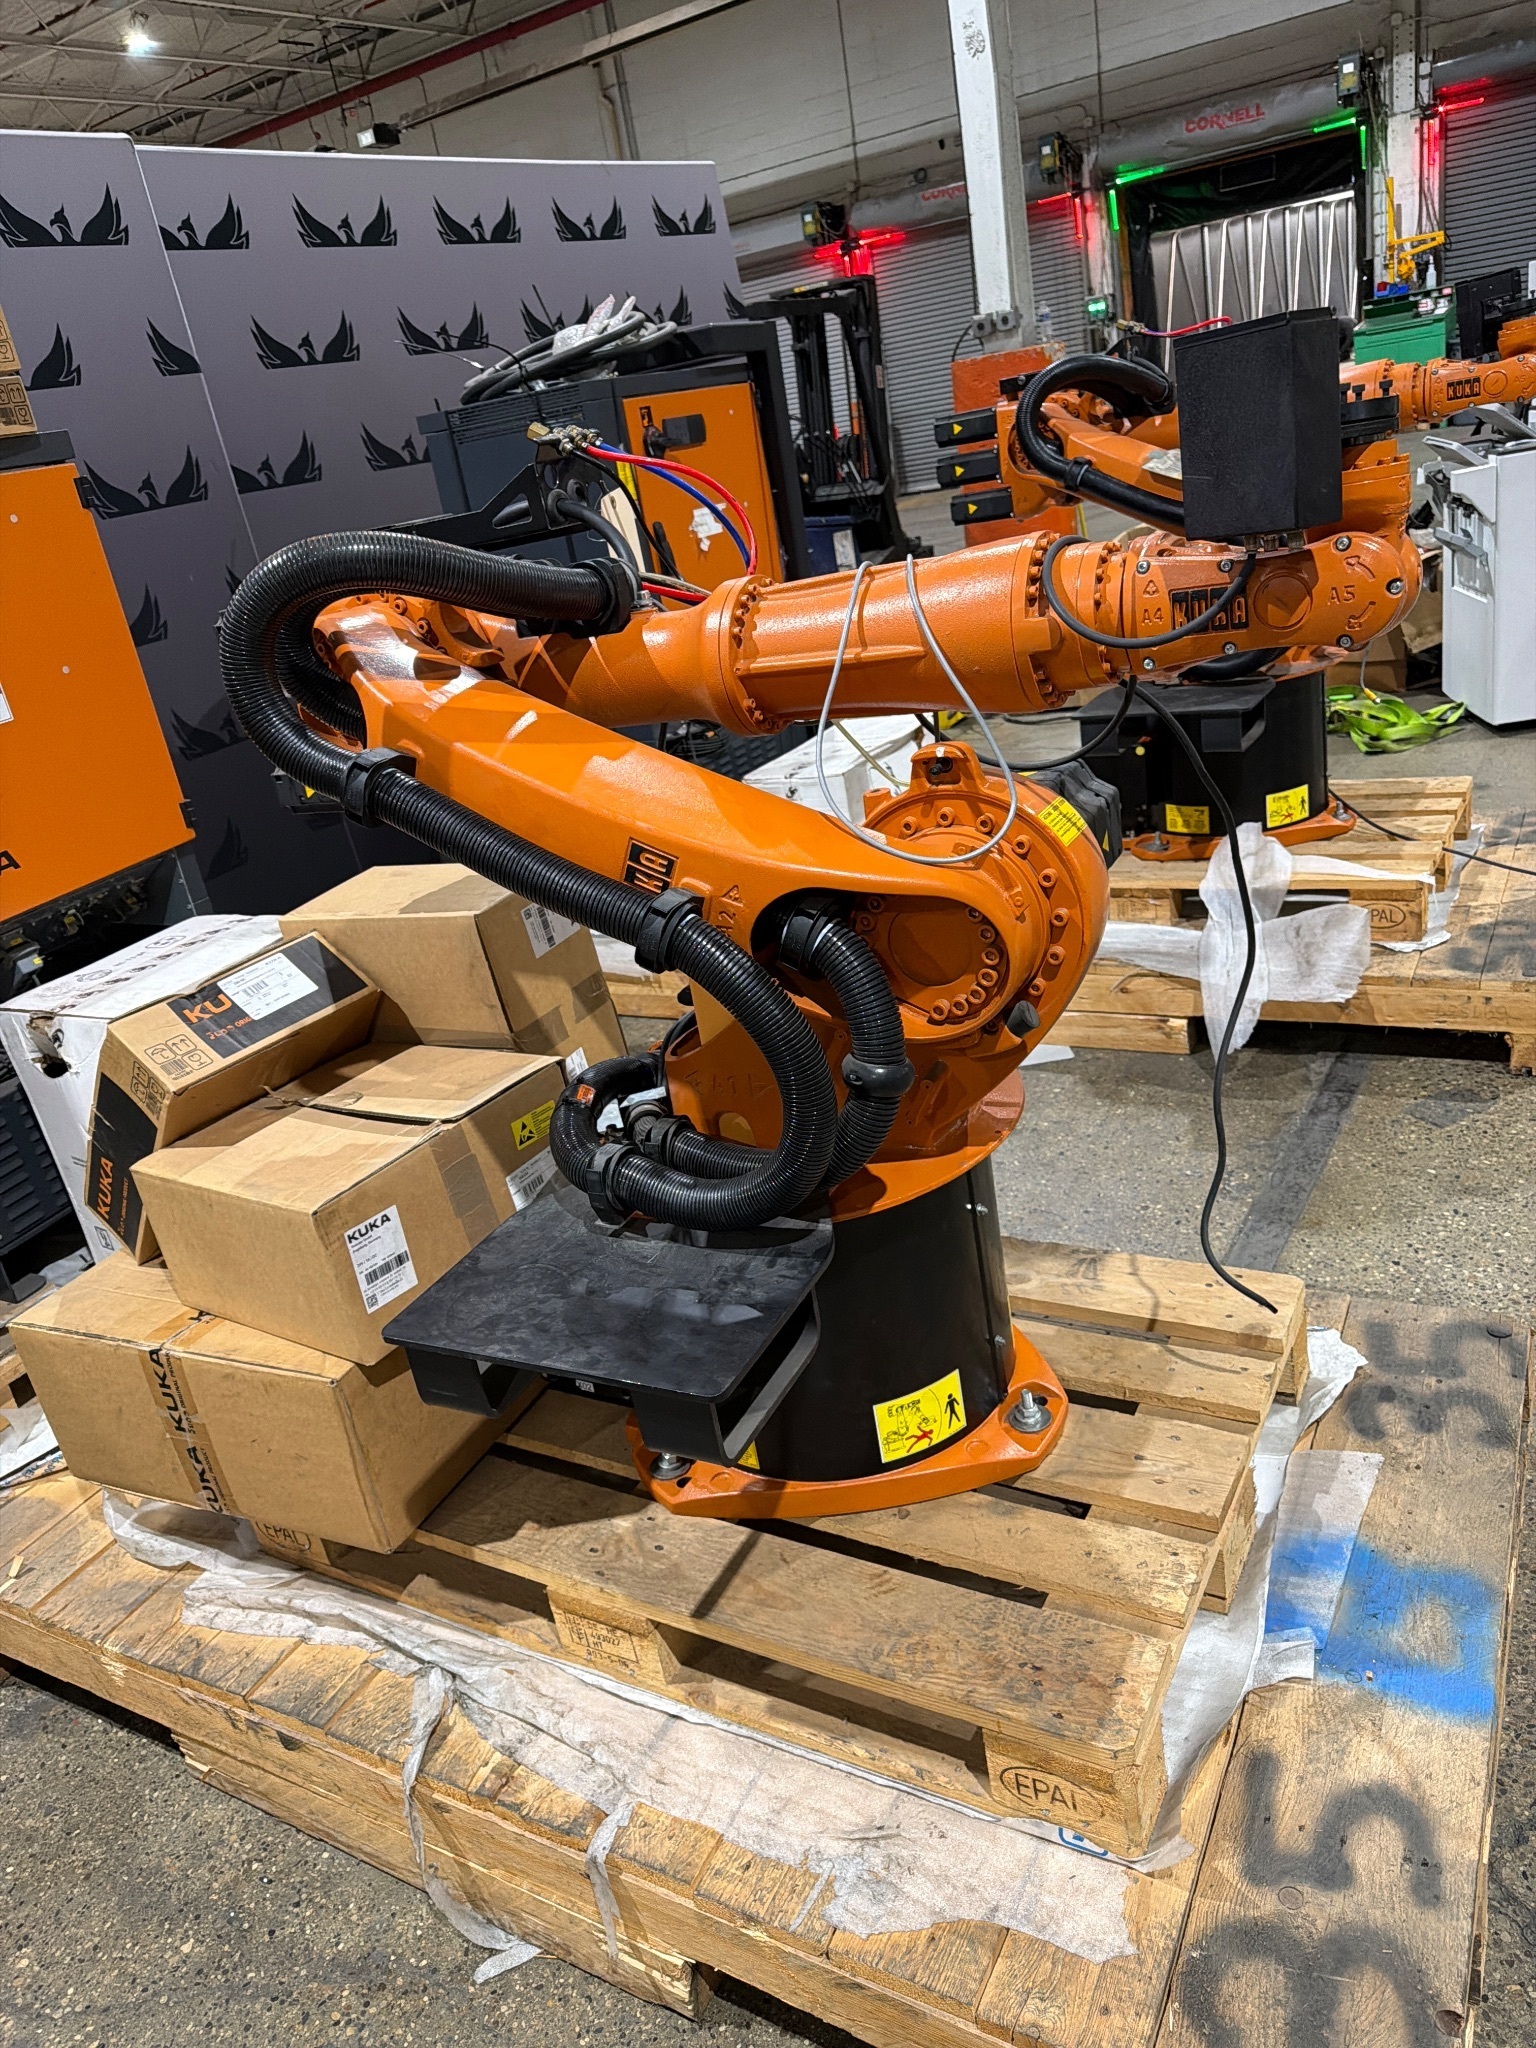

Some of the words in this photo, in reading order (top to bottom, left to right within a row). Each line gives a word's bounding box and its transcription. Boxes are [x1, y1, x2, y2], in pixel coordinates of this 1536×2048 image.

[1185, 103, 1265, 133] CORNELL
[1448, 382, 1479, 398] KUKA
[1327, 585, 1356, 605] A5
[1142, 607, 1164, 626] A4
[634, 852, 669, 894] KA
[1369, 907, 1398, 924] PAL
[182, 993, 232, 1024] KU
[234, 1015, 253, 1029] ORIG
[97, 1156, 114, 1220] KUKA
[347, 1213, 391, 1244] KUKA
[149, 1348, 187, 1433] KUKA
